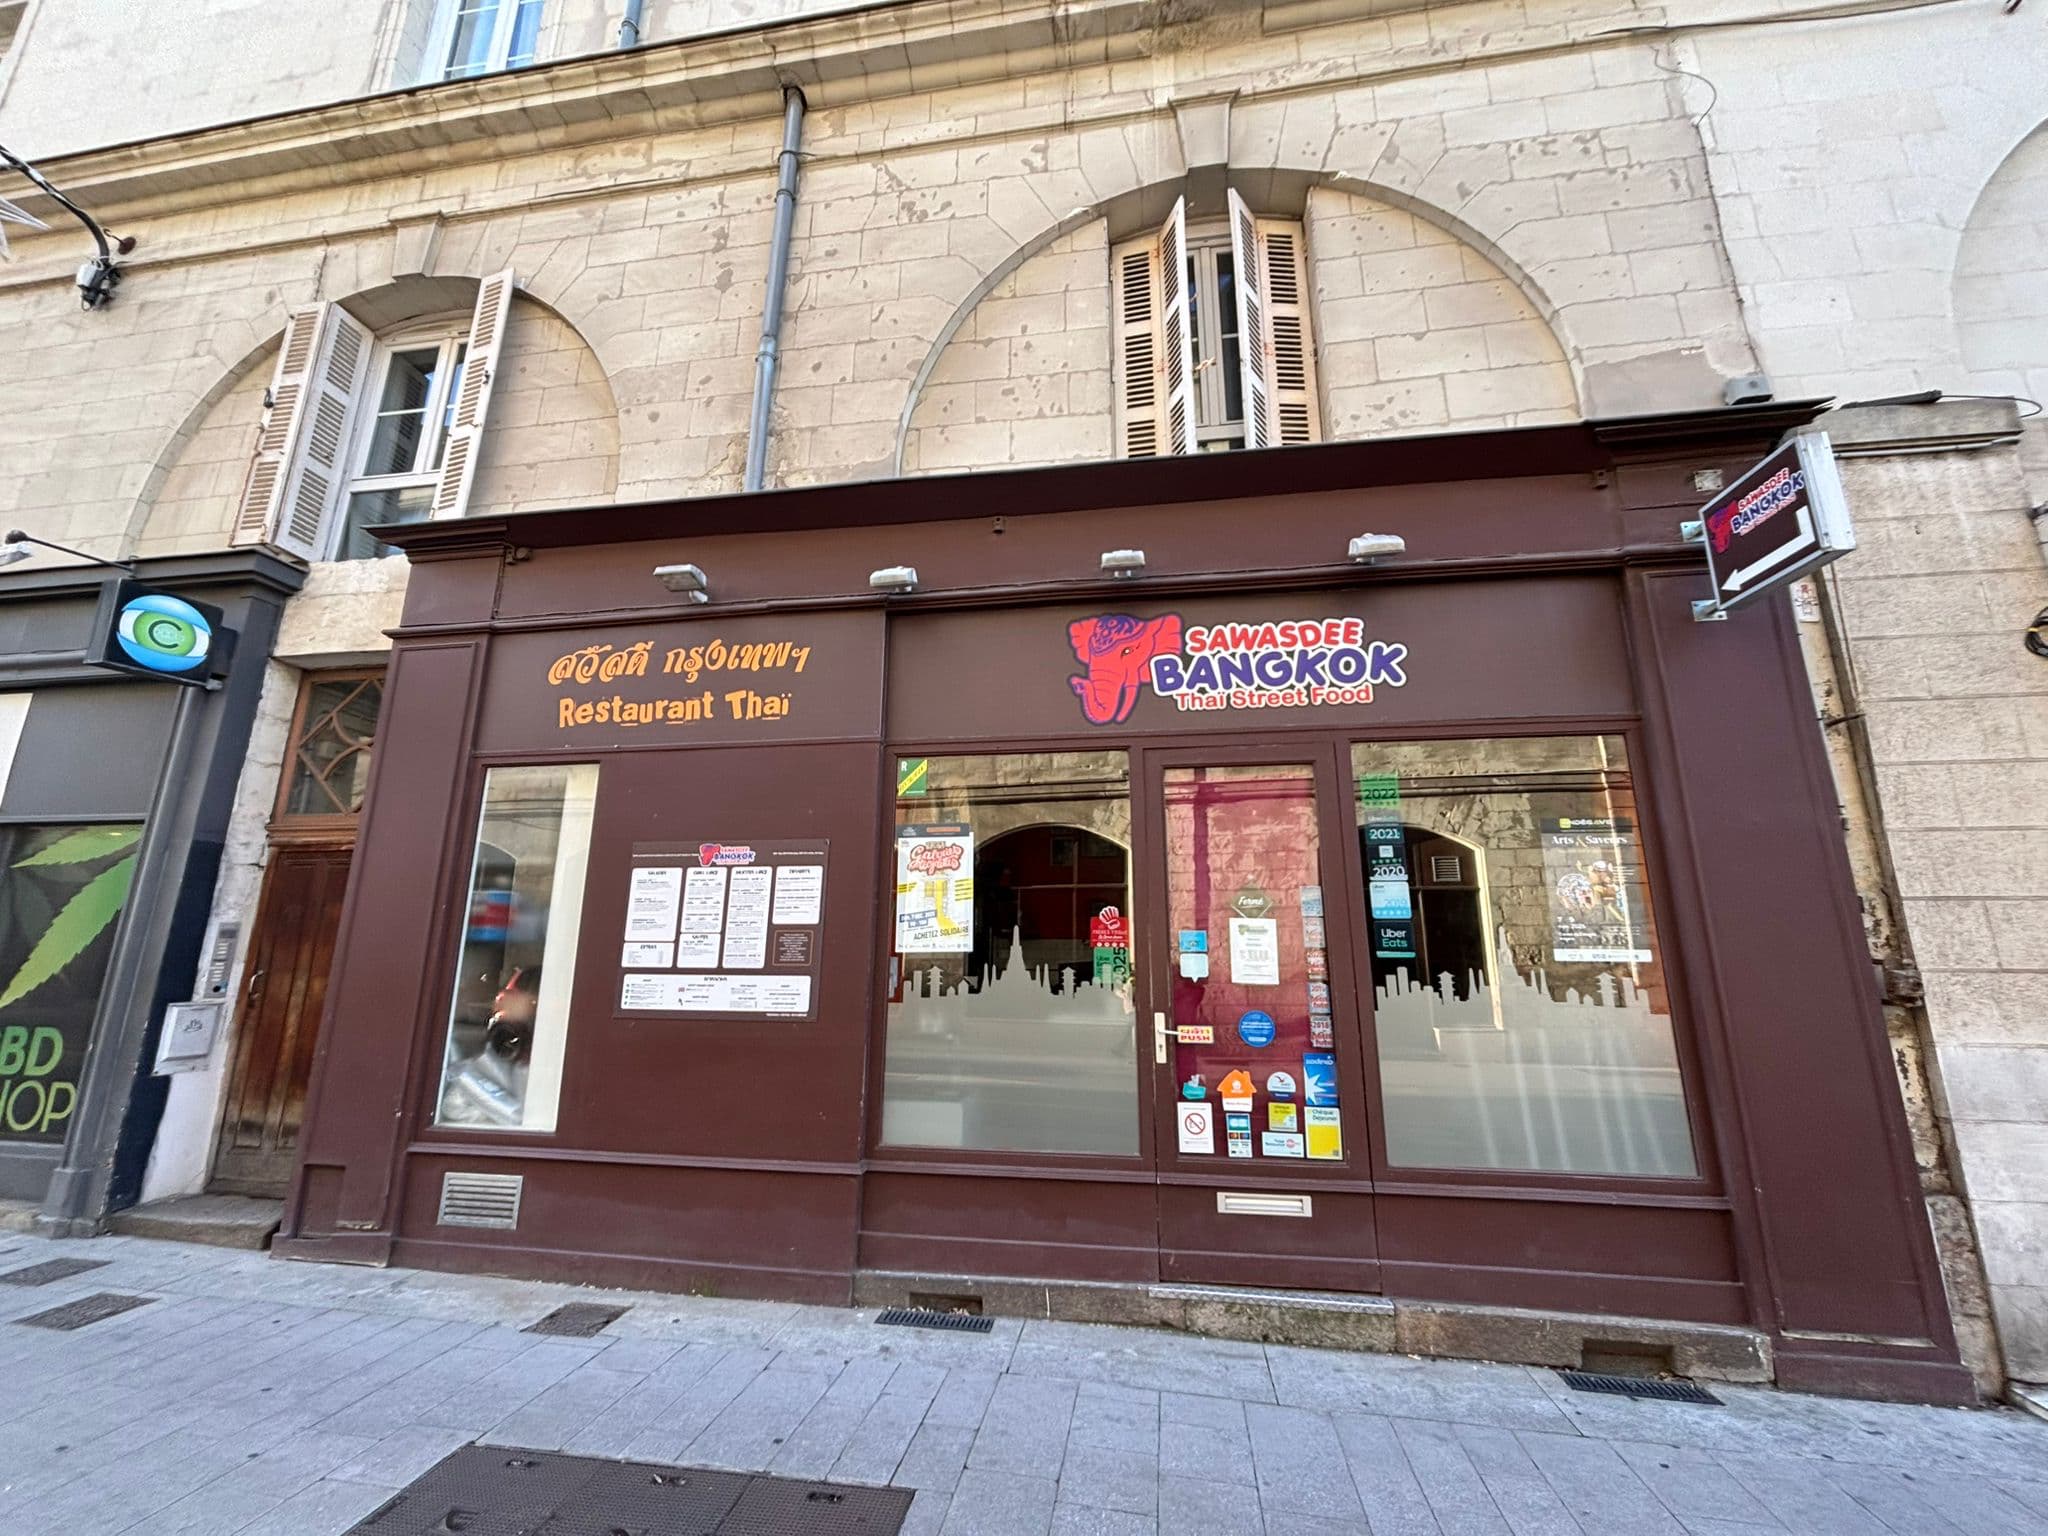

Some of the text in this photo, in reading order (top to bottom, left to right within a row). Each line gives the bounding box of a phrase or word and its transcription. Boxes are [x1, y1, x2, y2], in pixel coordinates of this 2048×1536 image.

[1739, 468, 1789, 511] SAWASDEE
[1731, 473, 1804, 532] BANGKOK
[1188, 621, 1361, 653] SAWASDEE
[548, 639, 810, 685] สวัสดี กรุงเทพฯ
[1154, 646, 1404, 692] BANGKOK
[1231, 688, 1304, 708] Street
[1312, 686, 1372, 705] Food
[559, 689, 793, 728] Restaurant Thaï
[1364, 788, 1398, 799] 2022
[1369, 828, 1400, 840] 2021
[1372, 865, 1406, 878] 2020
[914, 929, 938, 940] ACHETEZ
[1381, 928, 1406, 938] Uber
[1382, 938, 1408, 947] Eats
